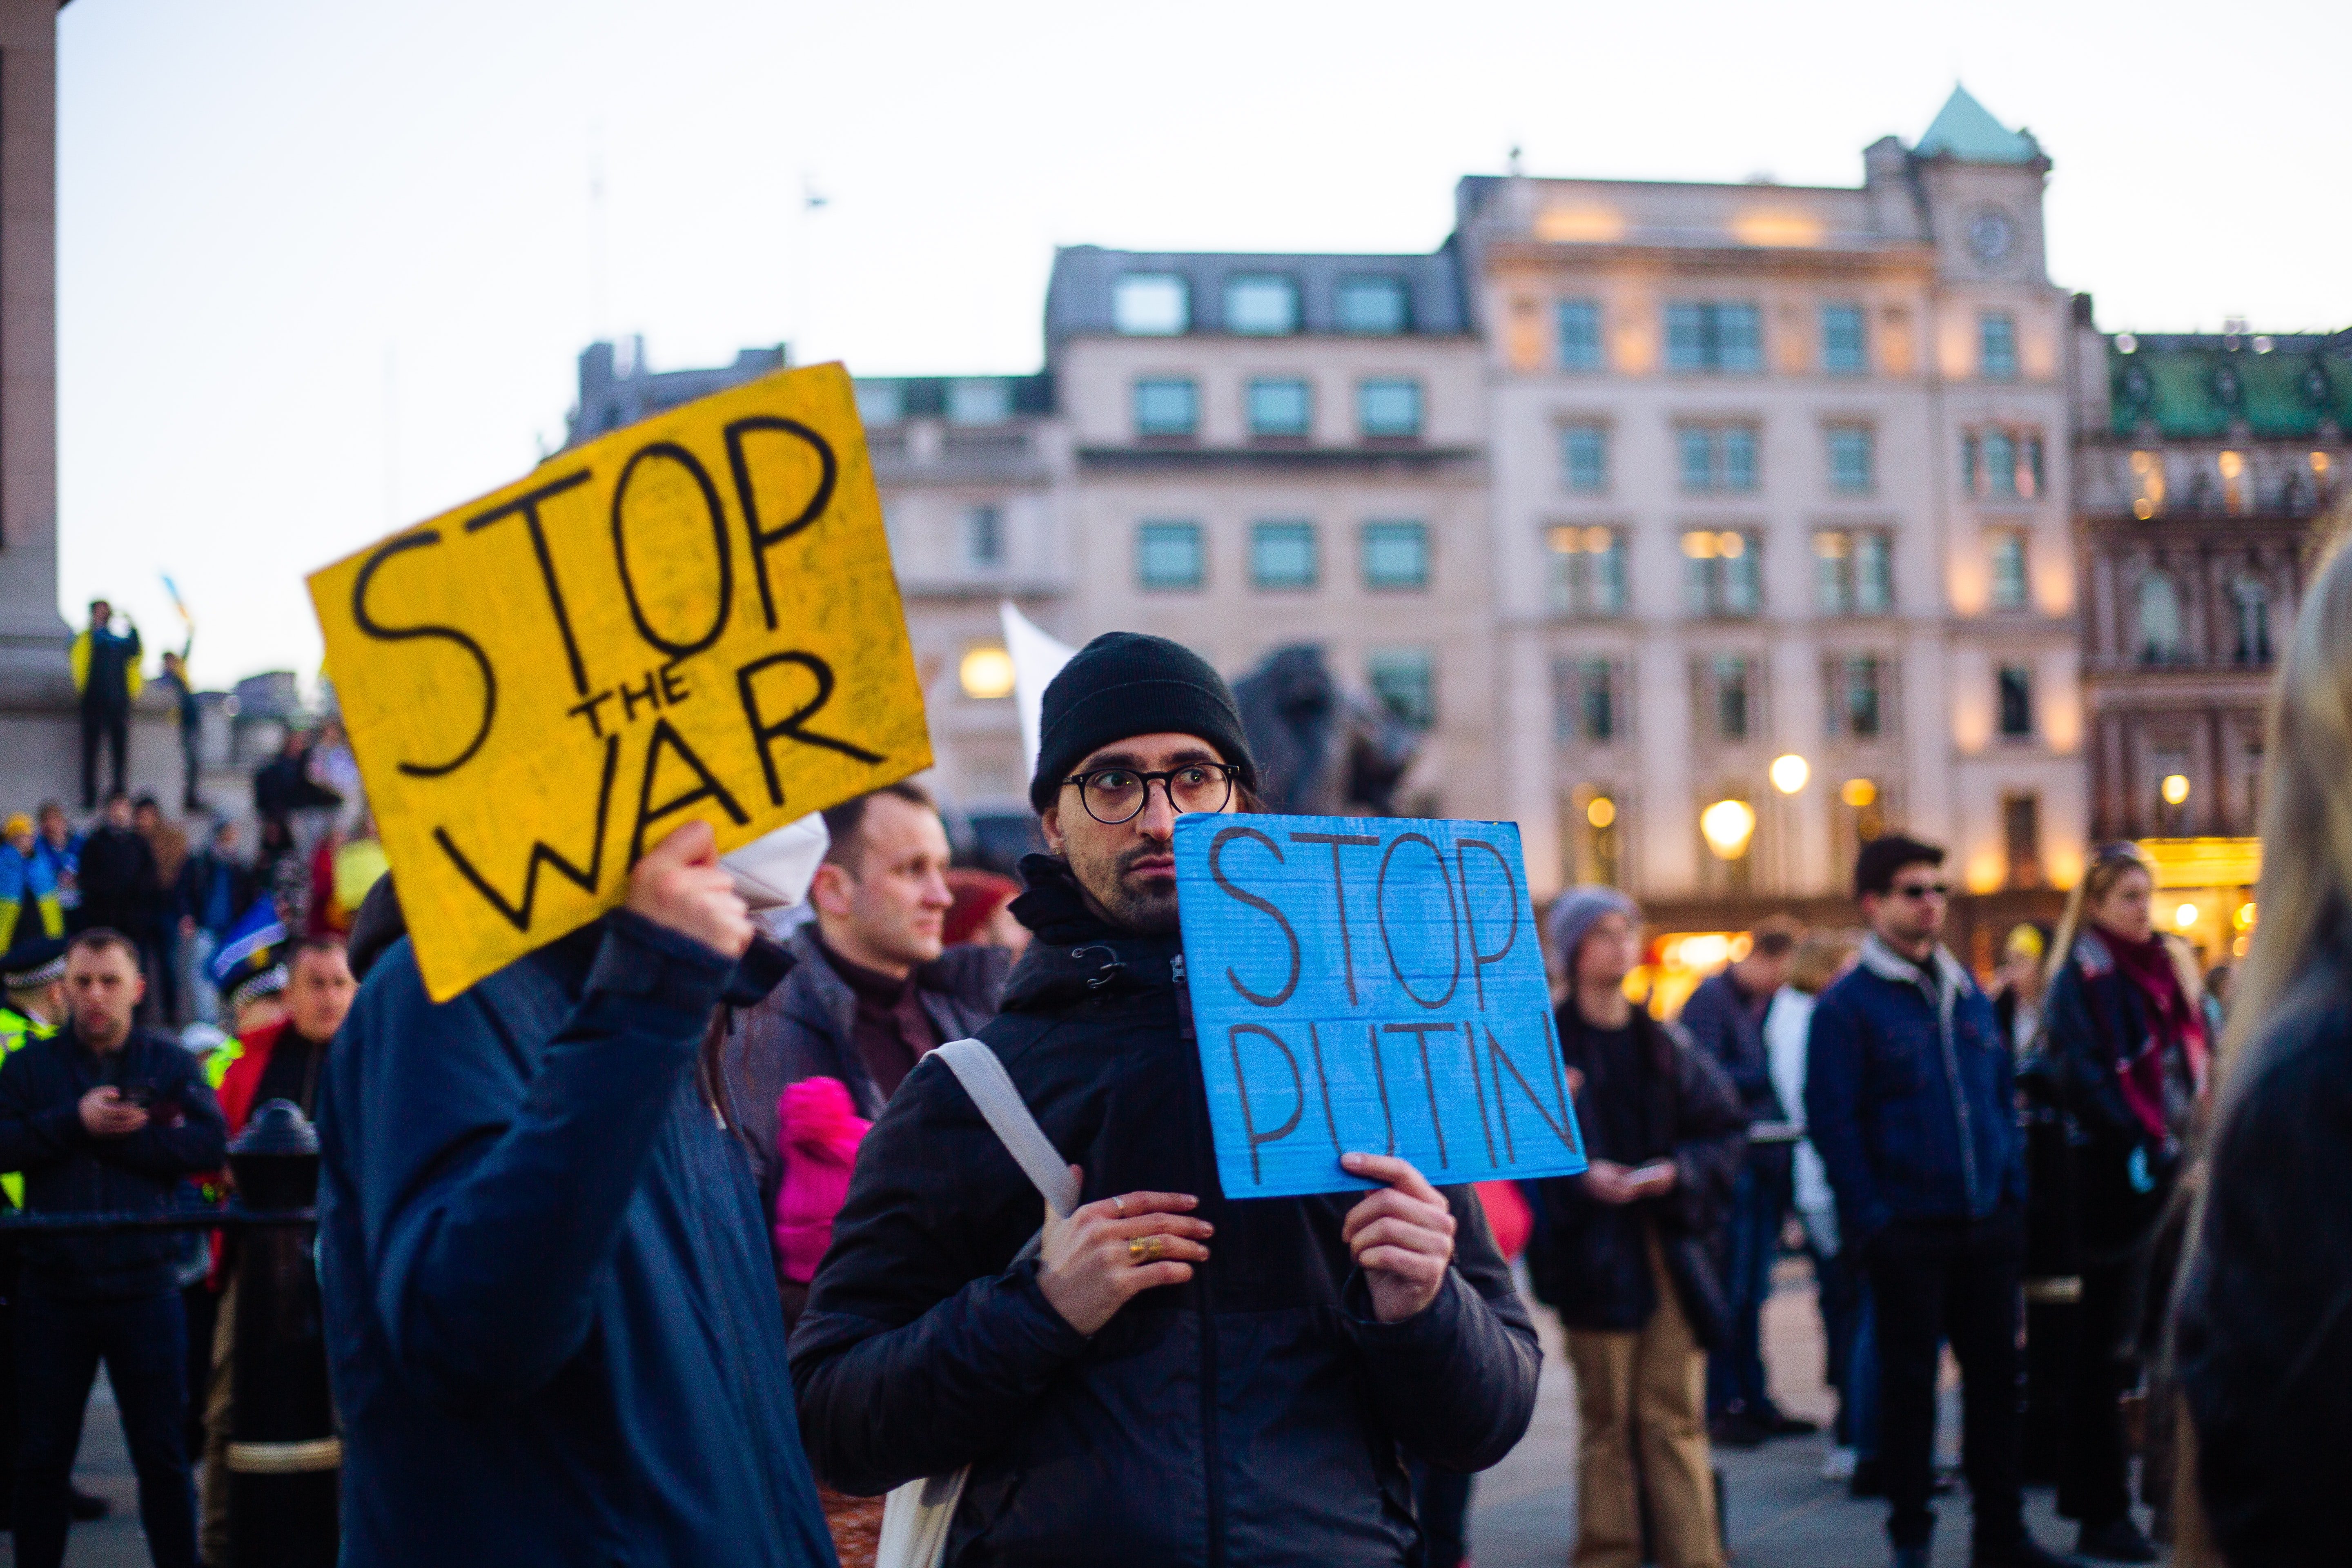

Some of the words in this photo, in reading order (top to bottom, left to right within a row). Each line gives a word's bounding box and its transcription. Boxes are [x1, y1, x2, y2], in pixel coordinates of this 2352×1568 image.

[352, 415, 837, 777] STOP
[434, 651, 887, 931] WAR
[568, 661, 691, 737] THE
[1208, 826, 1518, 1011] STOP
[1228, 1011, 1577, 1185] PUTIN
